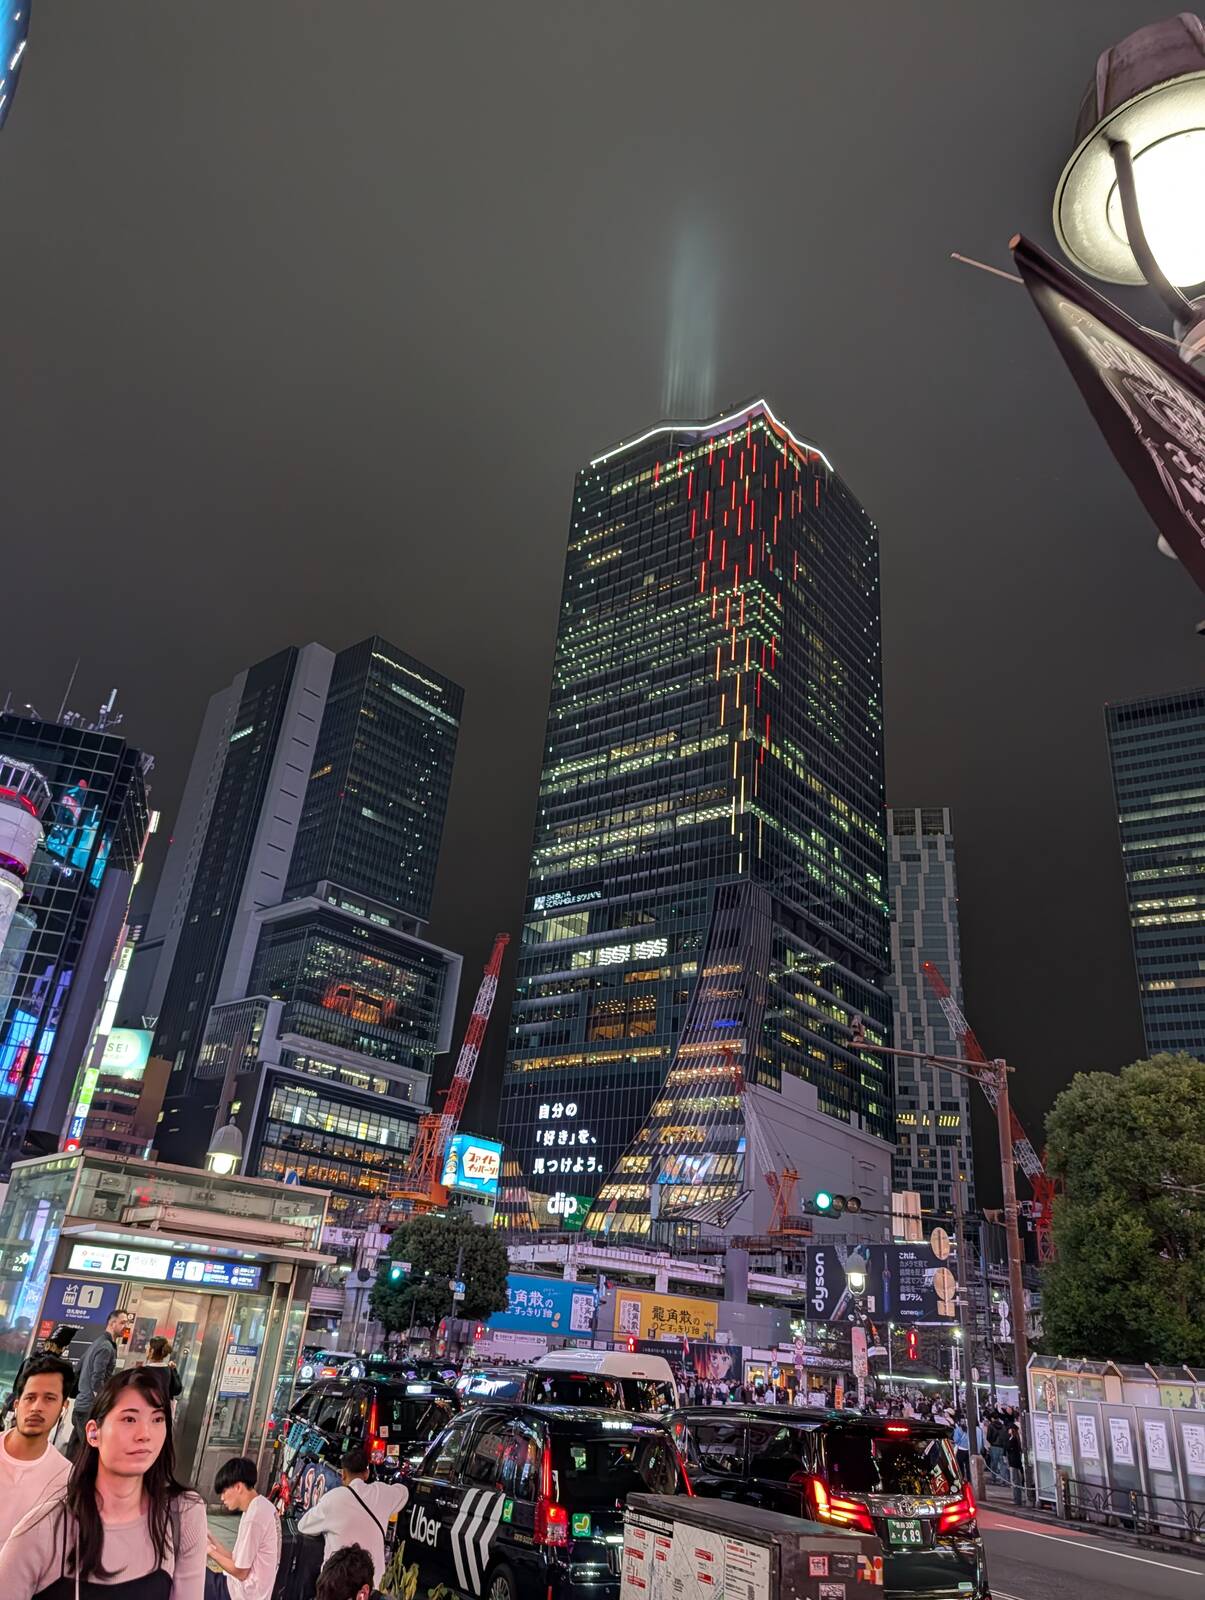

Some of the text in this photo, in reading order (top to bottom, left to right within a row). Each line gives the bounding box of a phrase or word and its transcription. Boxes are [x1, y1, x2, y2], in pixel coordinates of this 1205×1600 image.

[538, 1102, 577, 1120] 自分の
[536, 1129, 597, 1147] 「好き」を、
[532, 1156, 603, 1175] 見つけよう。
[547, 1192, 577, 1218] dip
[811, 1252, 829, 1312] dyson
[87, 1289, 95, 1304] 1
[652, 1305, 701, 1326] 龍角散の
[409, 1503, 442, 1548] Uber
